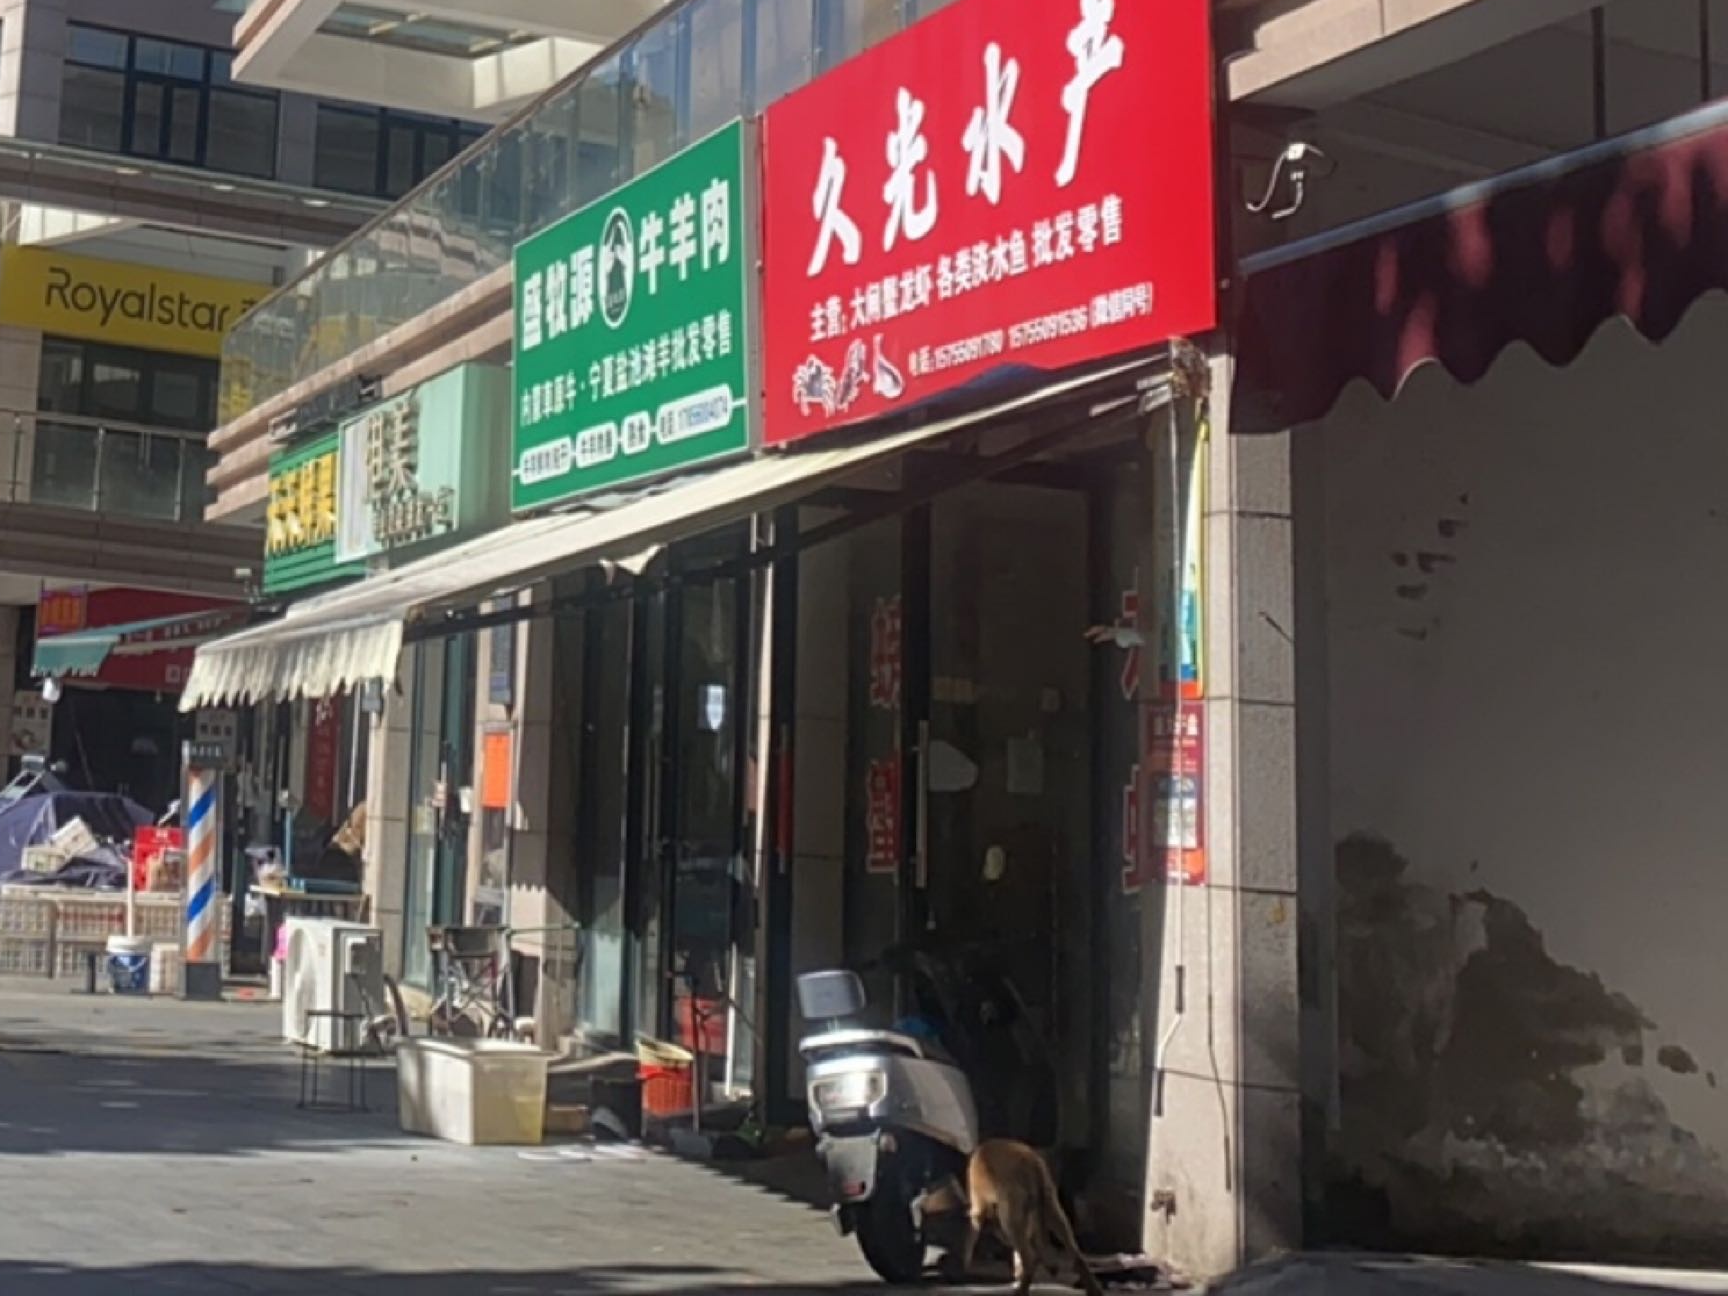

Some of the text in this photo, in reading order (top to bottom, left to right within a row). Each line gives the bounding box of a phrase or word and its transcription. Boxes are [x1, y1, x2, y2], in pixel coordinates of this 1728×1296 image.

[638, 176, 731, 296] 牛羊肉
[1031, 193, 1122, 268] 批发零售
[44, 266, 230, 333] Royalstar
